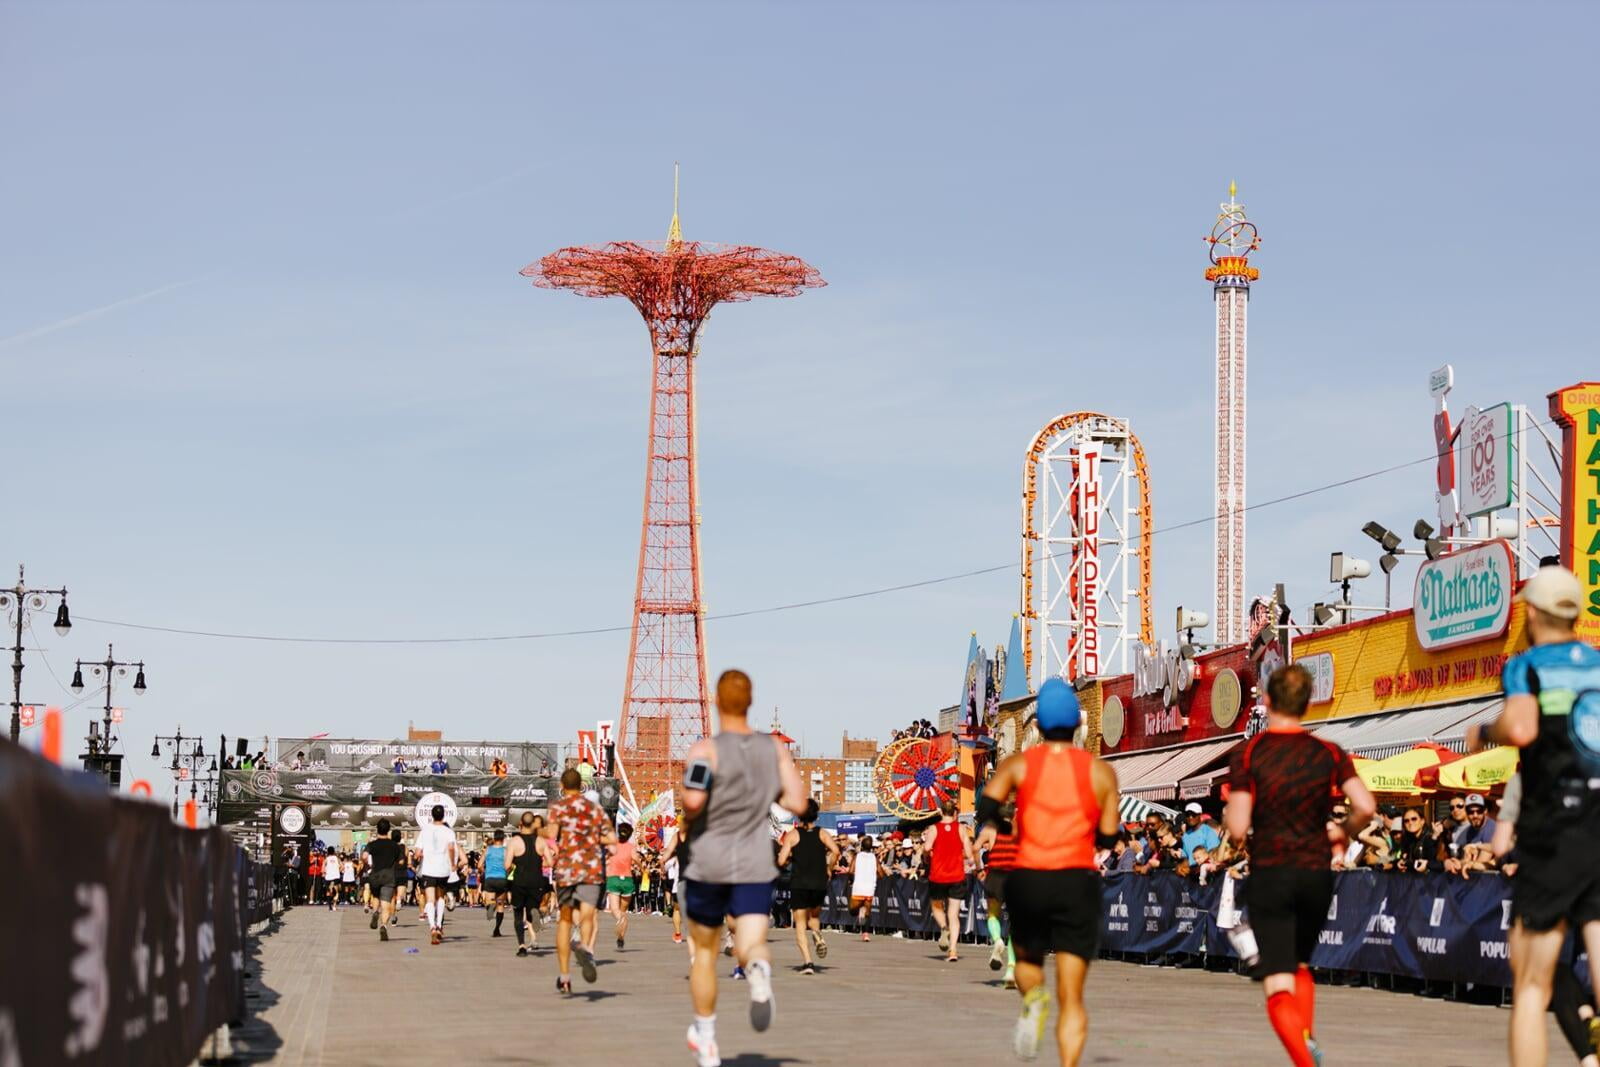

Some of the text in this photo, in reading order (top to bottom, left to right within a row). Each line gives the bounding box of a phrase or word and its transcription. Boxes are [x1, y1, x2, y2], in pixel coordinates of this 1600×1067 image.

[1471, 418, 1494, 442] FOR OVER
[1471, 433, 1495, 477] 100
[1470, 465, 1496, 496] YEARS
[1421, 556, 1501, 621] Nathan's
[1448, 621, 1475, 635] FAMOUS
[1437, 664, 1450, 686] OF
[1453, 658, 1476, 683] NEW
[330, 744, 507, 758] YOU CRUSHED THE RUN, NOW ROCK THE PARTY!
[1318, 930, 1343, 945] OPULAR
[1417, 936, 1446, 954] POPULAR
